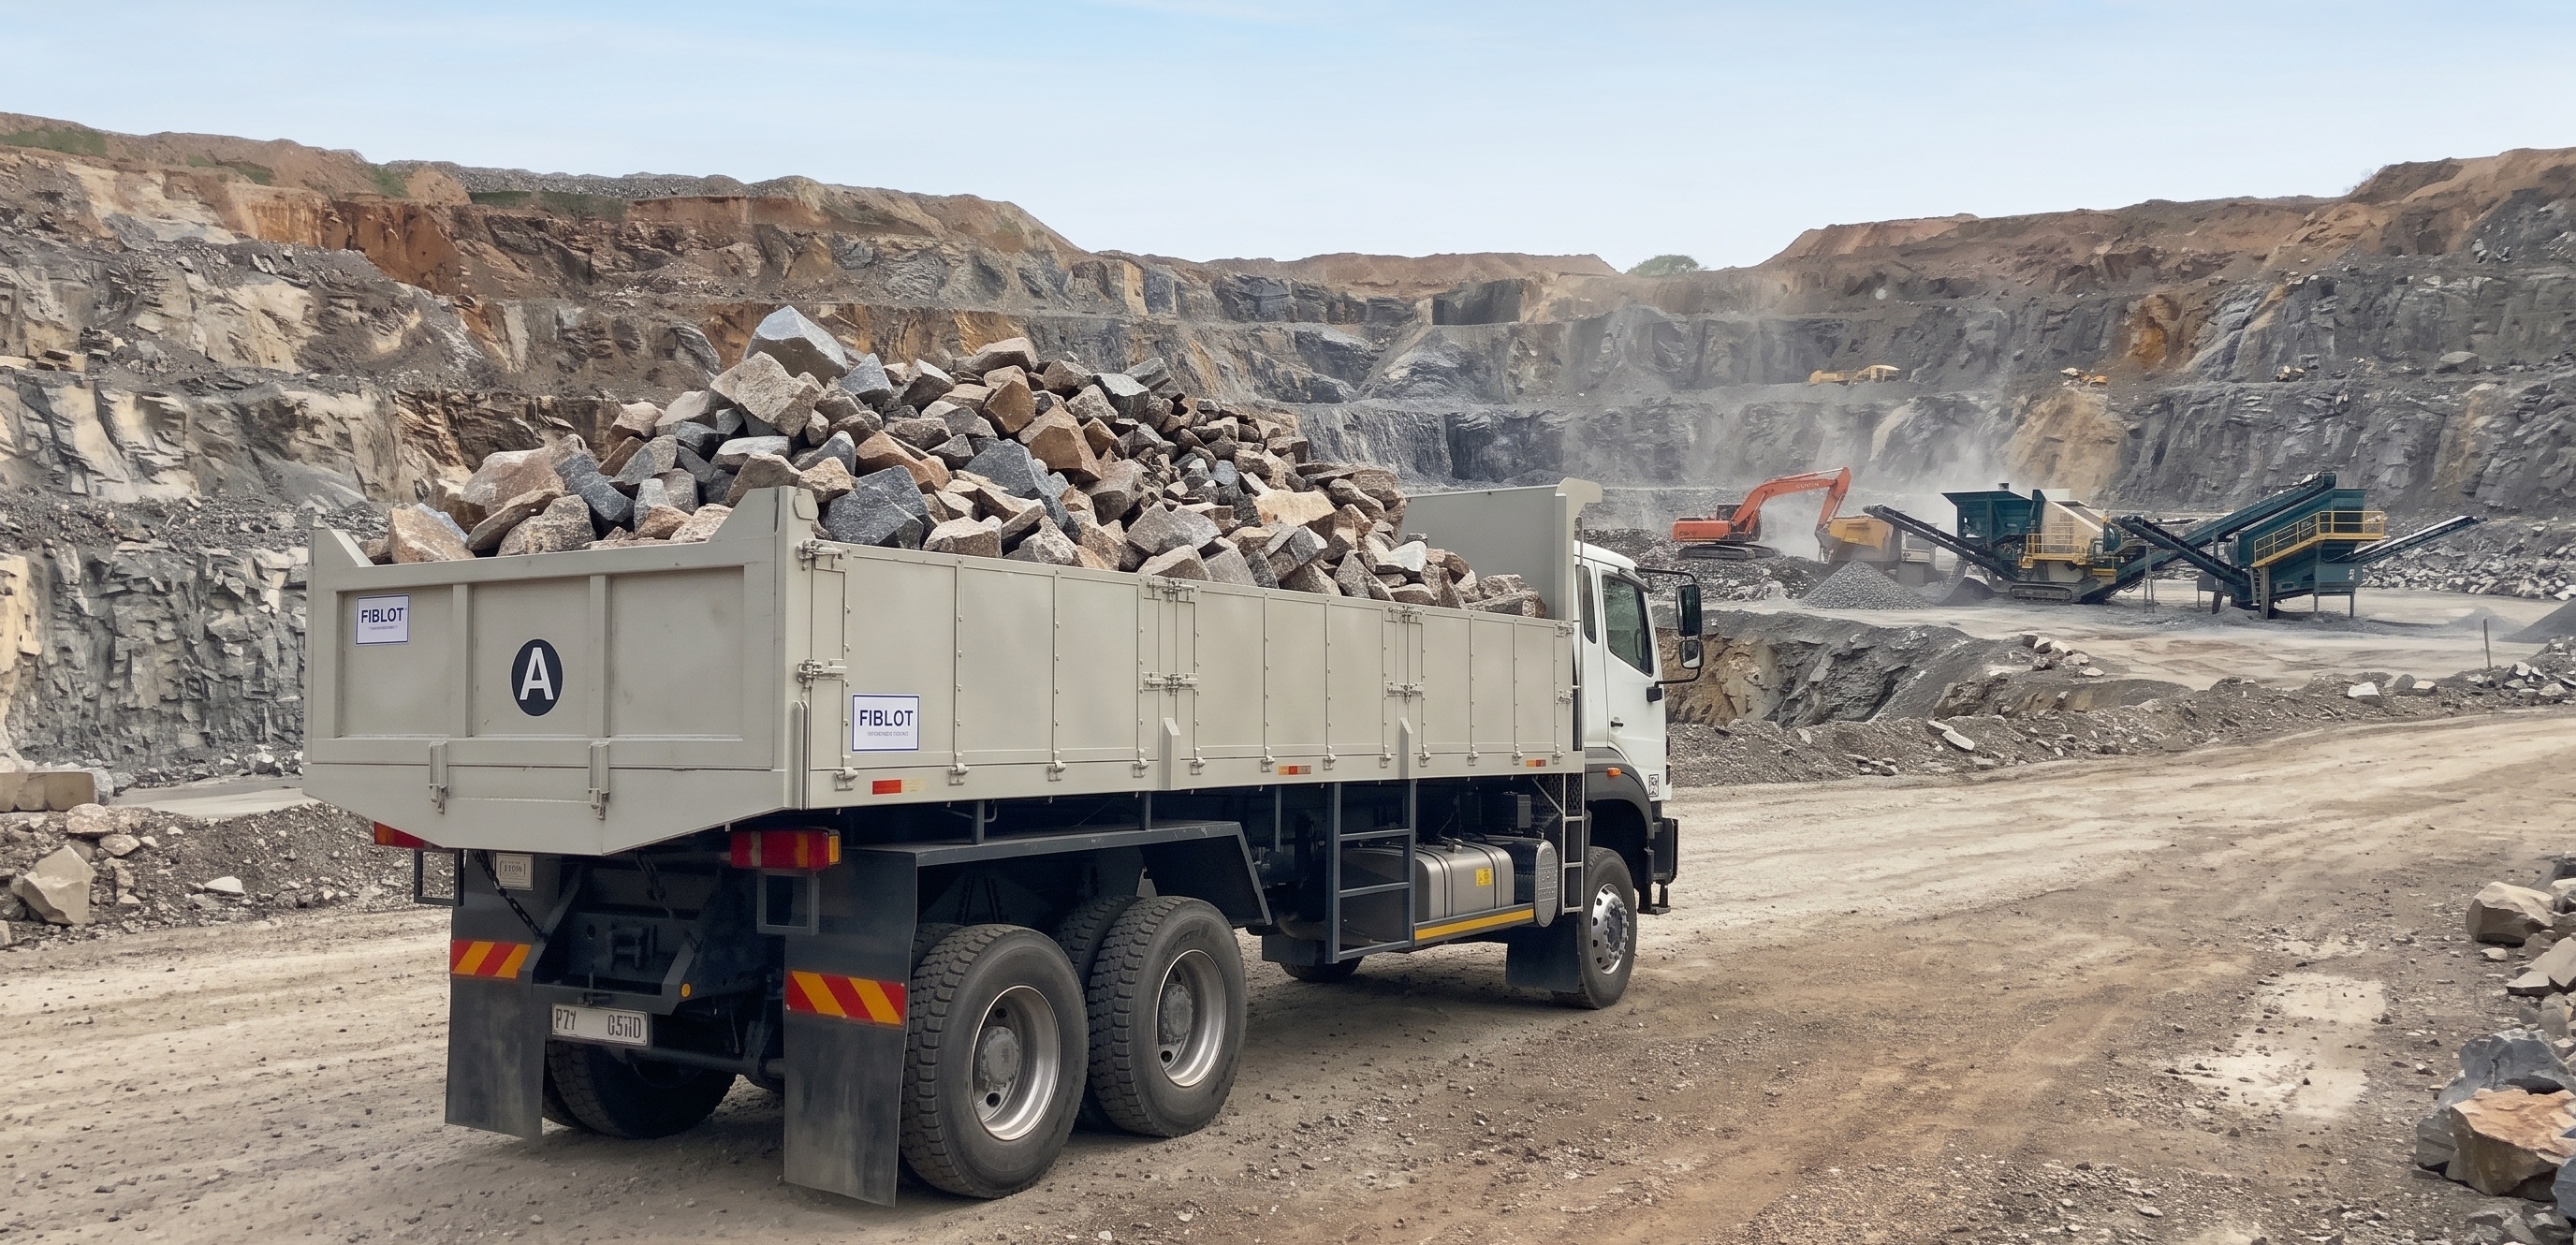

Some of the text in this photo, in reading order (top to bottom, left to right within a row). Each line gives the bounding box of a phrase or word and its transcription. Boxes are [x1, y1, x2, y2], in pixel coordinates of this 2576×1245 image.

[361, 608, 404, 623] FIBLOT
[519, 647, 554, 700] A
[859, 710, 914, 726] FIBLOT
